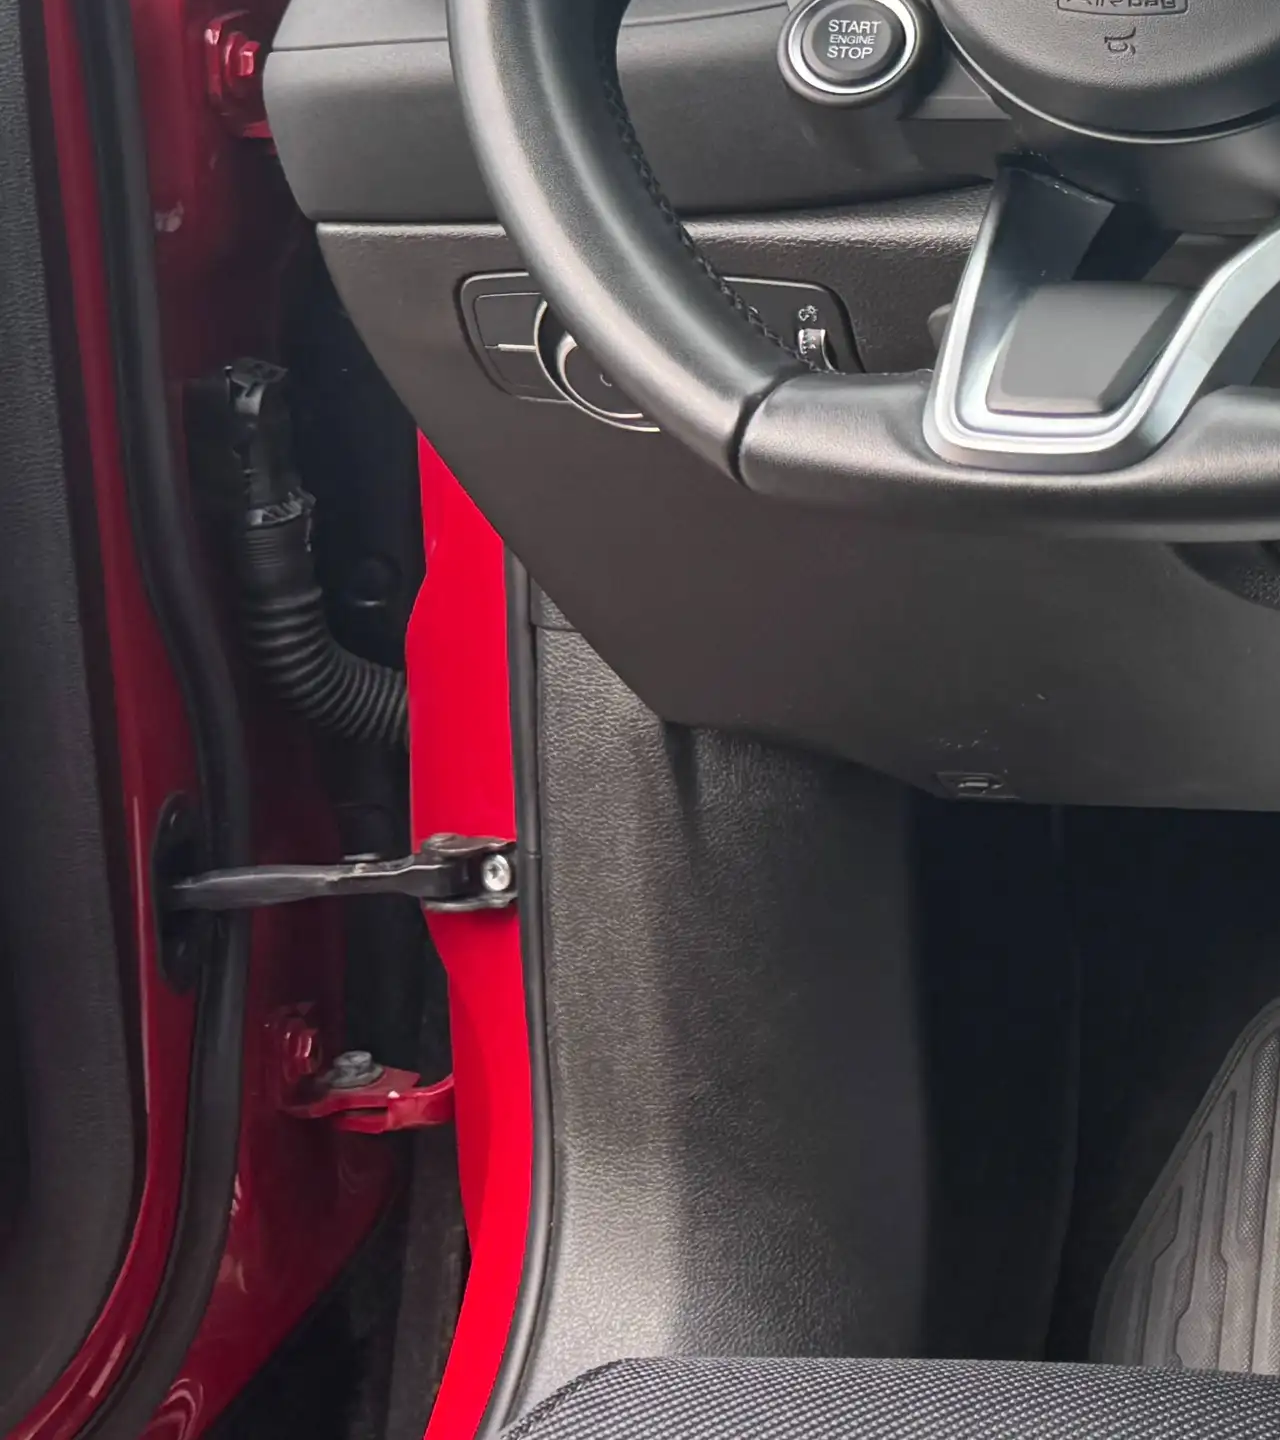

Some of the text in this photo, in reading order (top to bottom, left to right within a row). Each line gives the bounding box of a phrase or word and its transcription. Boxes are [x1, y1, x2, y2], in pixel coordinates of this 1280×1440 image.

[828, 19, 882, 34] START
[829, 33, 876, 45] ENGINE
[826, 46, 873, 60] STOP
